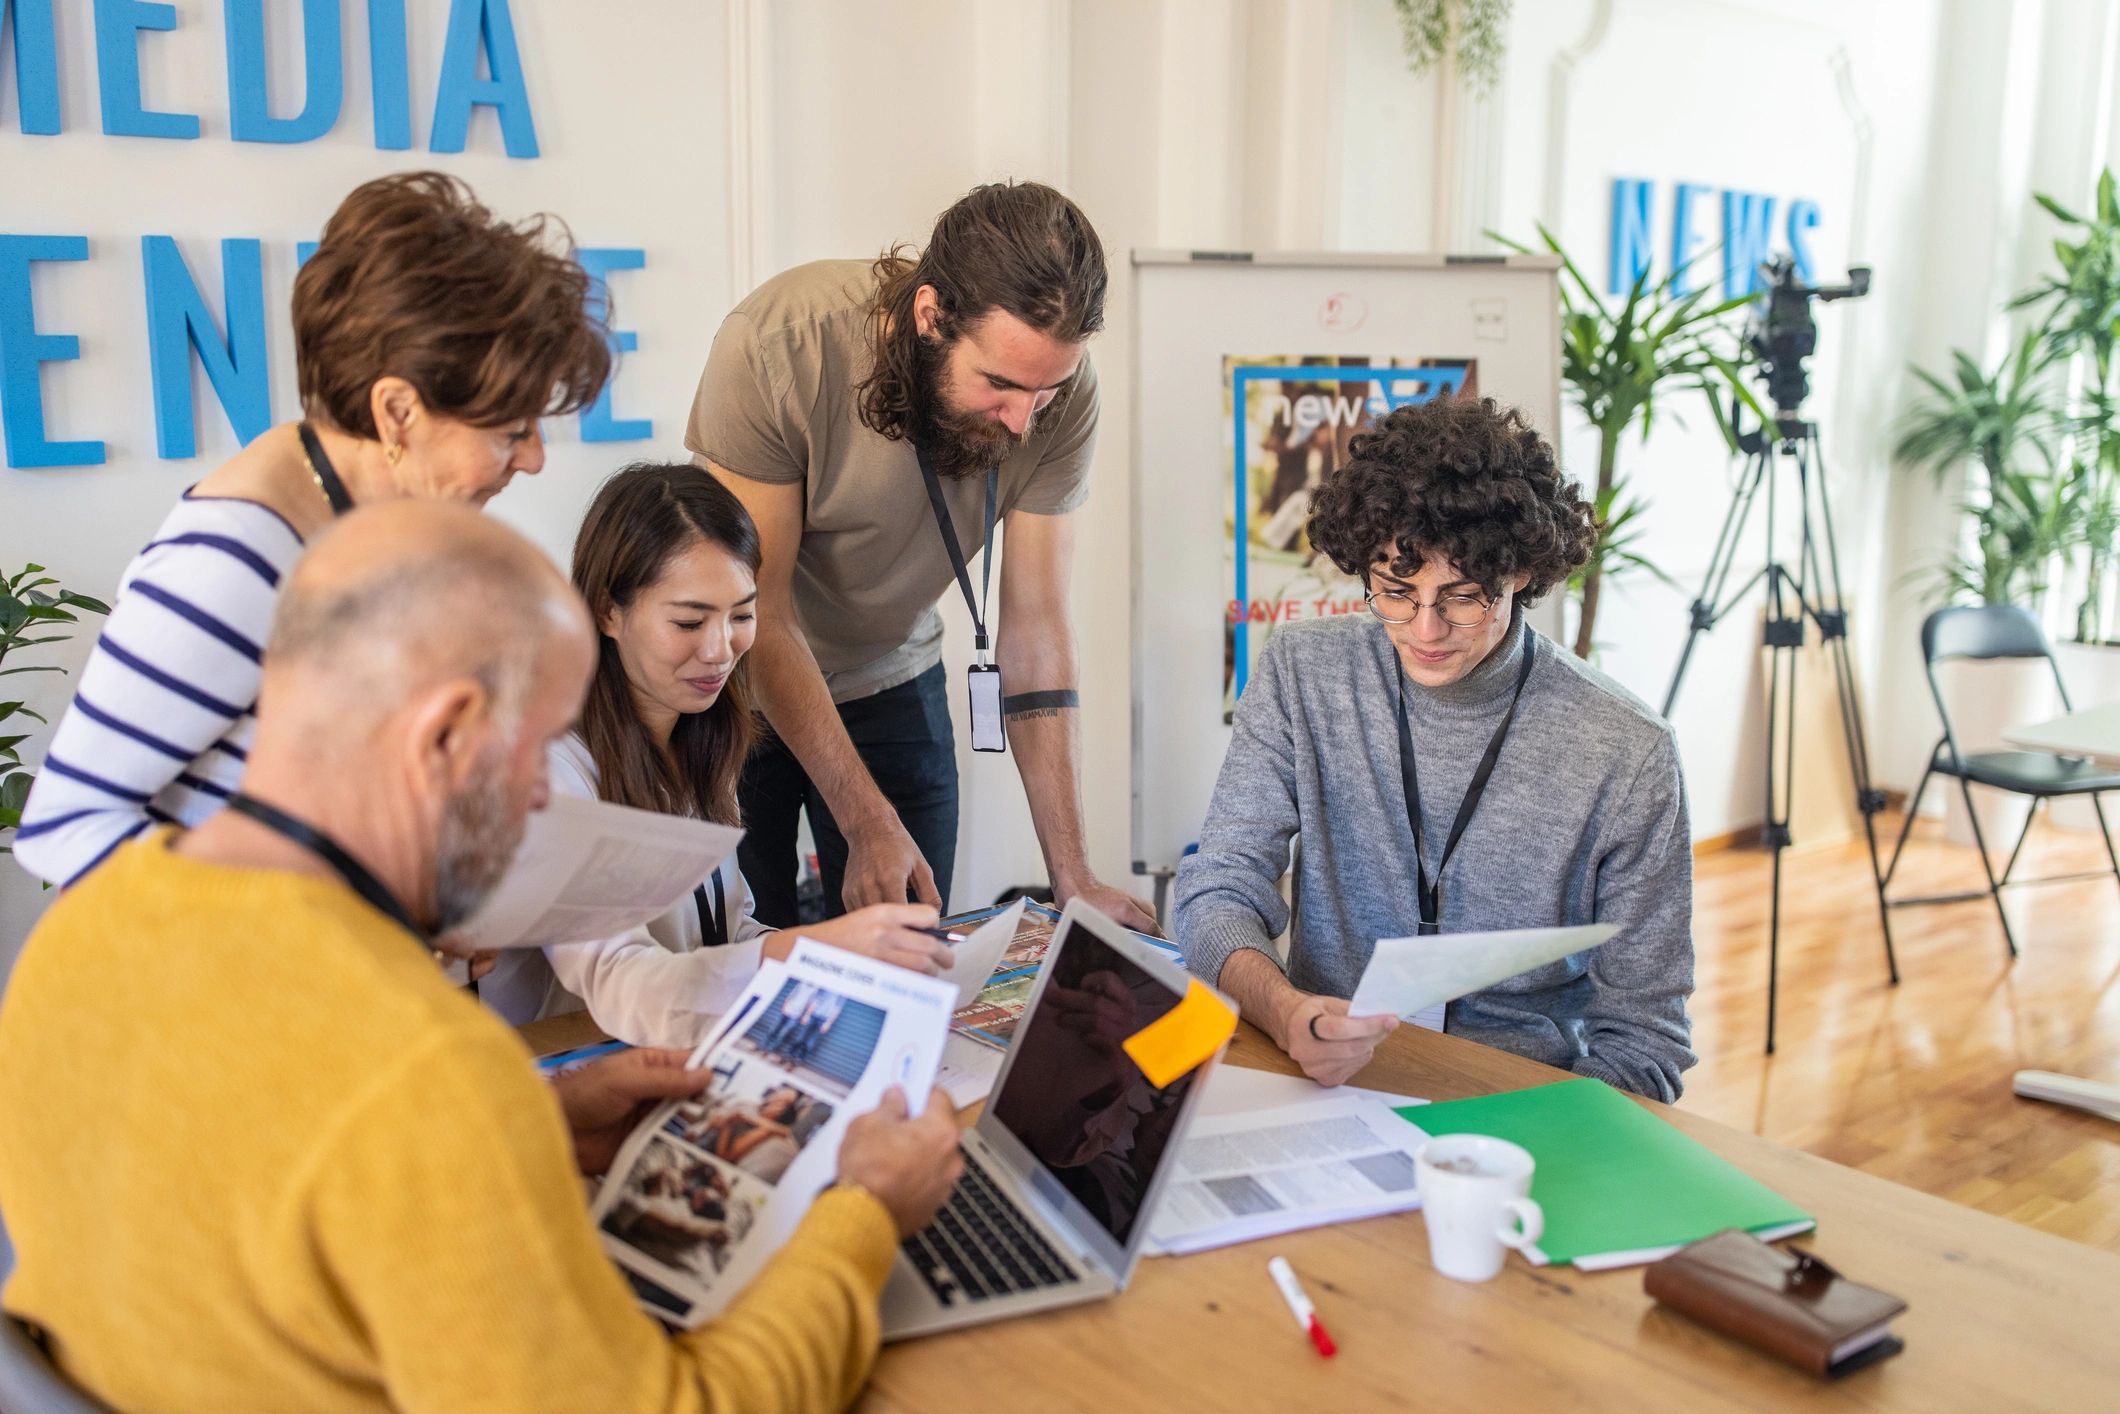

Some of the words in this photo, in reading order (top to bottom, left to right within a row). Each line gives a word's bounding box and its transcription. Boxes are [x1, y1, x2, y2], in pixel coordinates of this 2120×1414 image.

[1608, 177, 1822, 315] NEWS
[0, 235, 653, 468] ENE
[1226, 599, 1301, 624] SAVE
